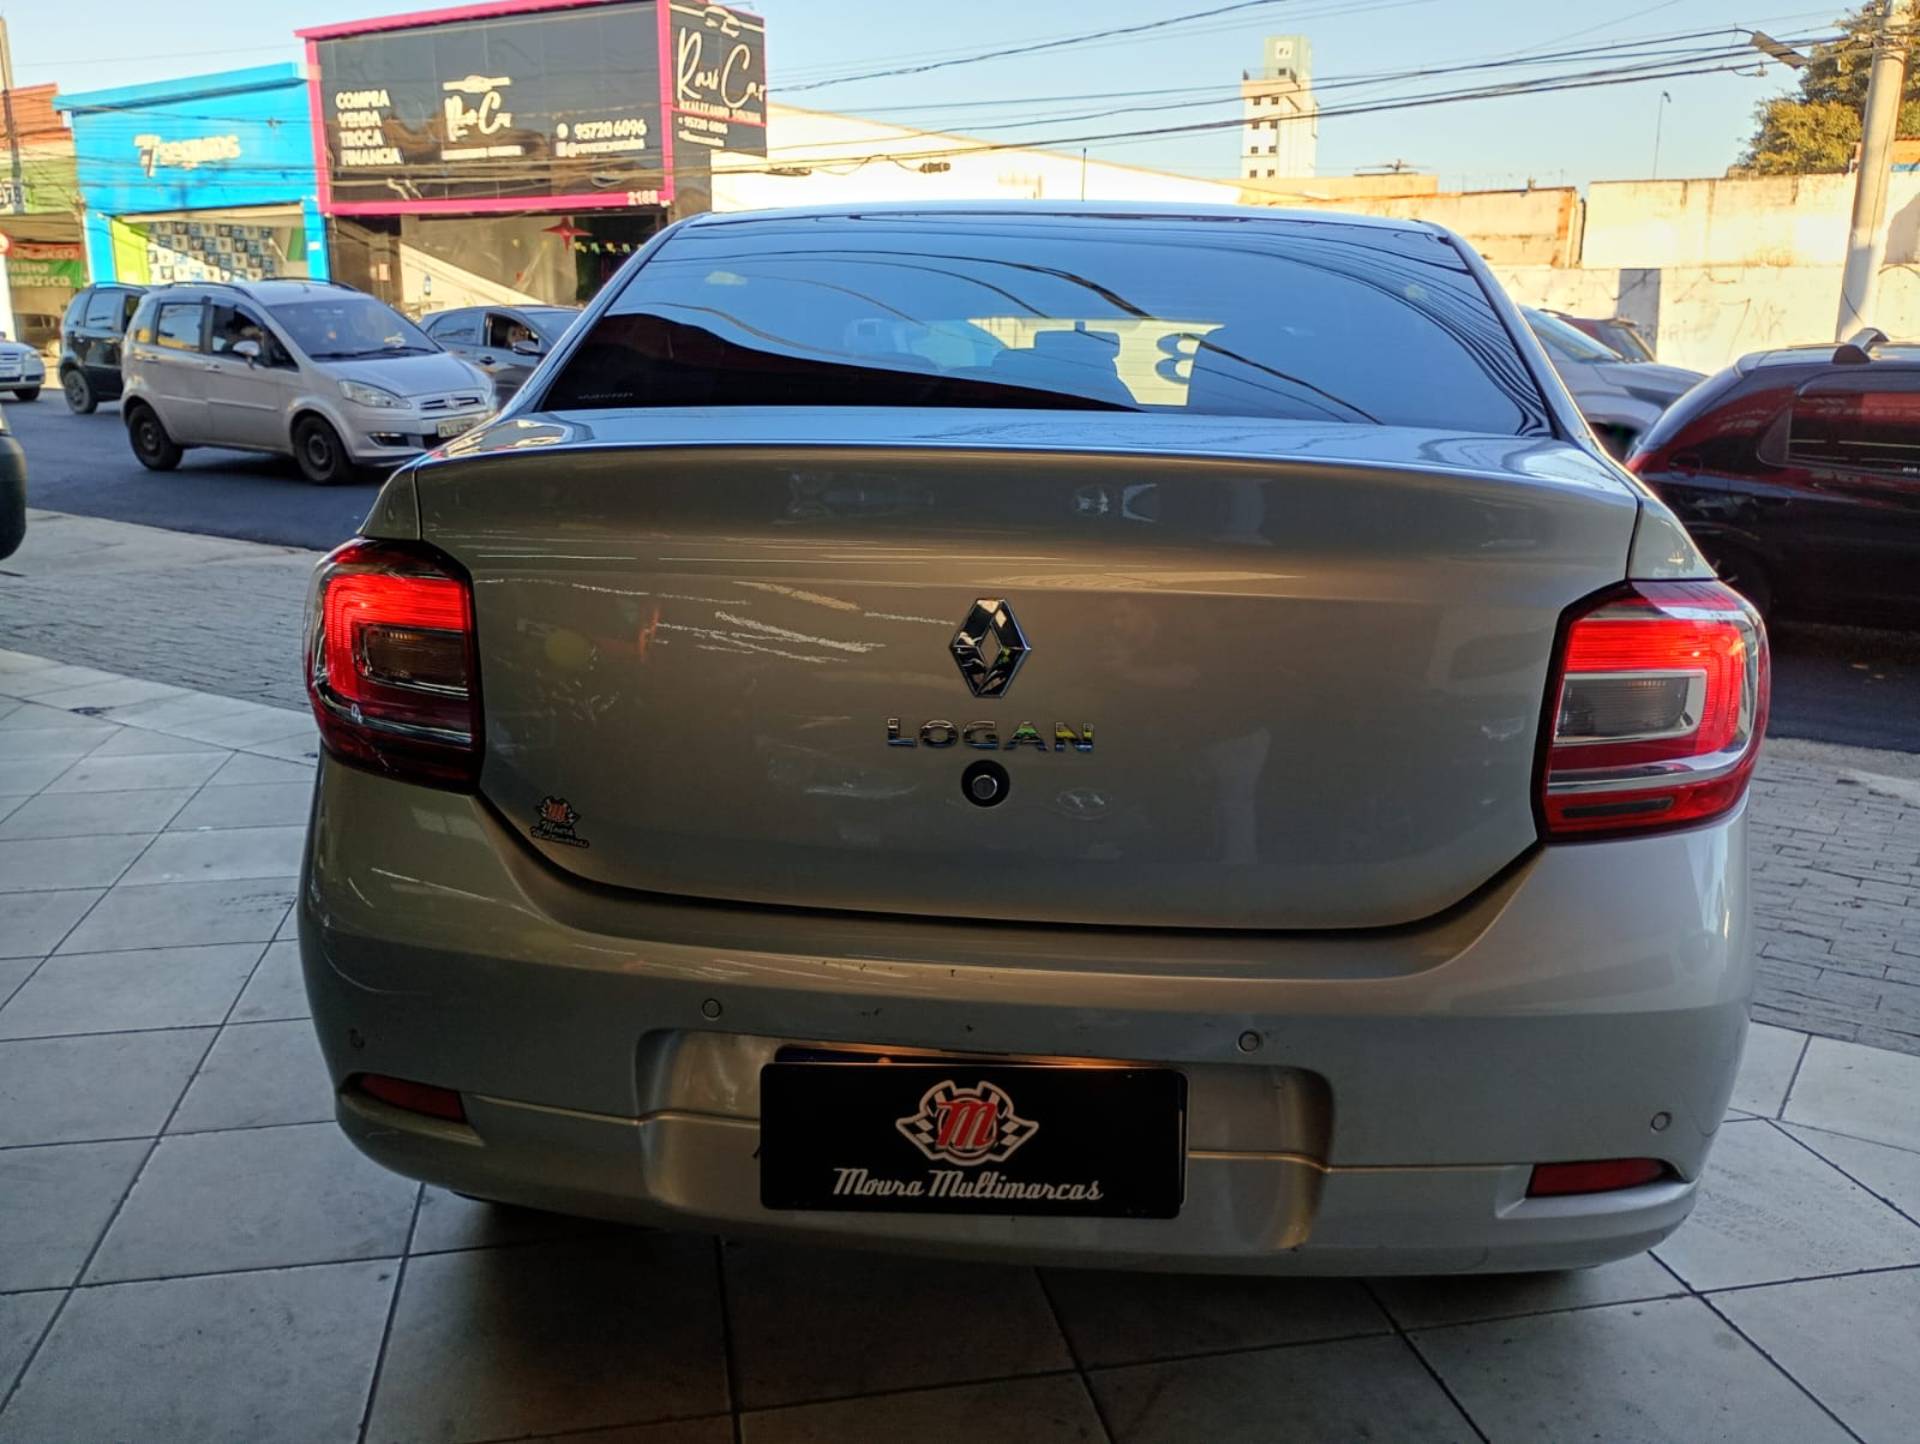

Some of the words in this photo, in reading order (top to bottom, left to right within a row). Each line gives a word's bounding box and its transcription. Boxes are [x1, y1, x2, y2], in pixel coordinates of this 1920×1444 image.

[721, 44, 767, 109] Car
[335, 89, 391, 109] COMPRA
[337, 110, 382, 128] VENDA
[613, 119, 647, 136] 6096
[339, 130, 384, 147] TROCA
[341, 148, 402, 166] FINANCIA
[887, 717, 1095, 752] LOGAN
[832, 1167, 925, 1198] Moura
[927, 1169, 1105, 1201] Multimarcas
